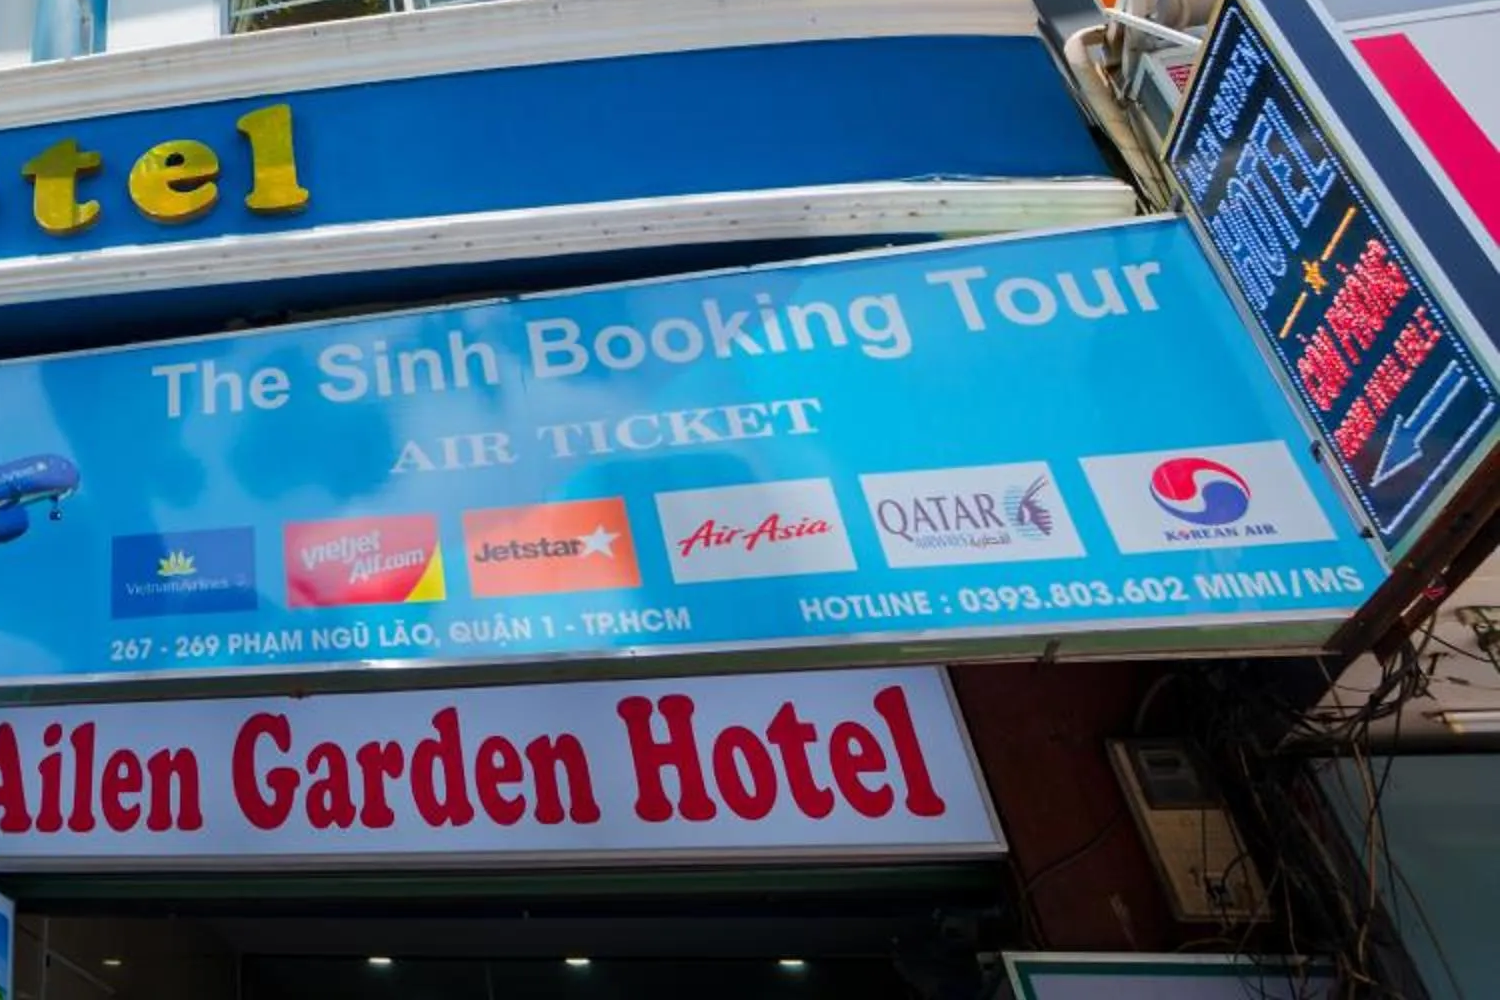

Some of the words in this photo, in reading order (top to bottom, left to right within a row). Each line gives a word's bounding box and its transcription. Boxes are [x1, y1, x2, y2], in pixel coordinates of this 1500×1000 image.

[1211, 97, 1337, 312] HOTEL
[152, 359, 290, 418] The
[318, 331, 500, 403] Sinh
[526, 293, 913, 379] Booking
[925, 260, 1163, 332] Tour
[390, 433, 519, 474] AIR
[537, 397, 823, 459] TICKET
[877, 493, 1007, 542] QATAR
[1241, 523, 1277, 538] AIR
[475, 537, 582, 564] Jetstar
[800, 590, 931, 622] HOTLINE
[959, 575, 1188, 614] 0393.803.602
[111, 637, 151, 662] 267
[176, 633, 219, 658] 269
[228, 629, 302, 659] PHẠM
[312, 620, 369, 649] NGŨ
[379, 619, 441, 648] LÃO,
[449, 612, 531, 647] QUẬN
[541, 615, 555, 638] 1
[581, 606, 691, 636] TP.HCM
[232, 706, 601, 830] Garden
[617, 685, 946, 823] Hotel
